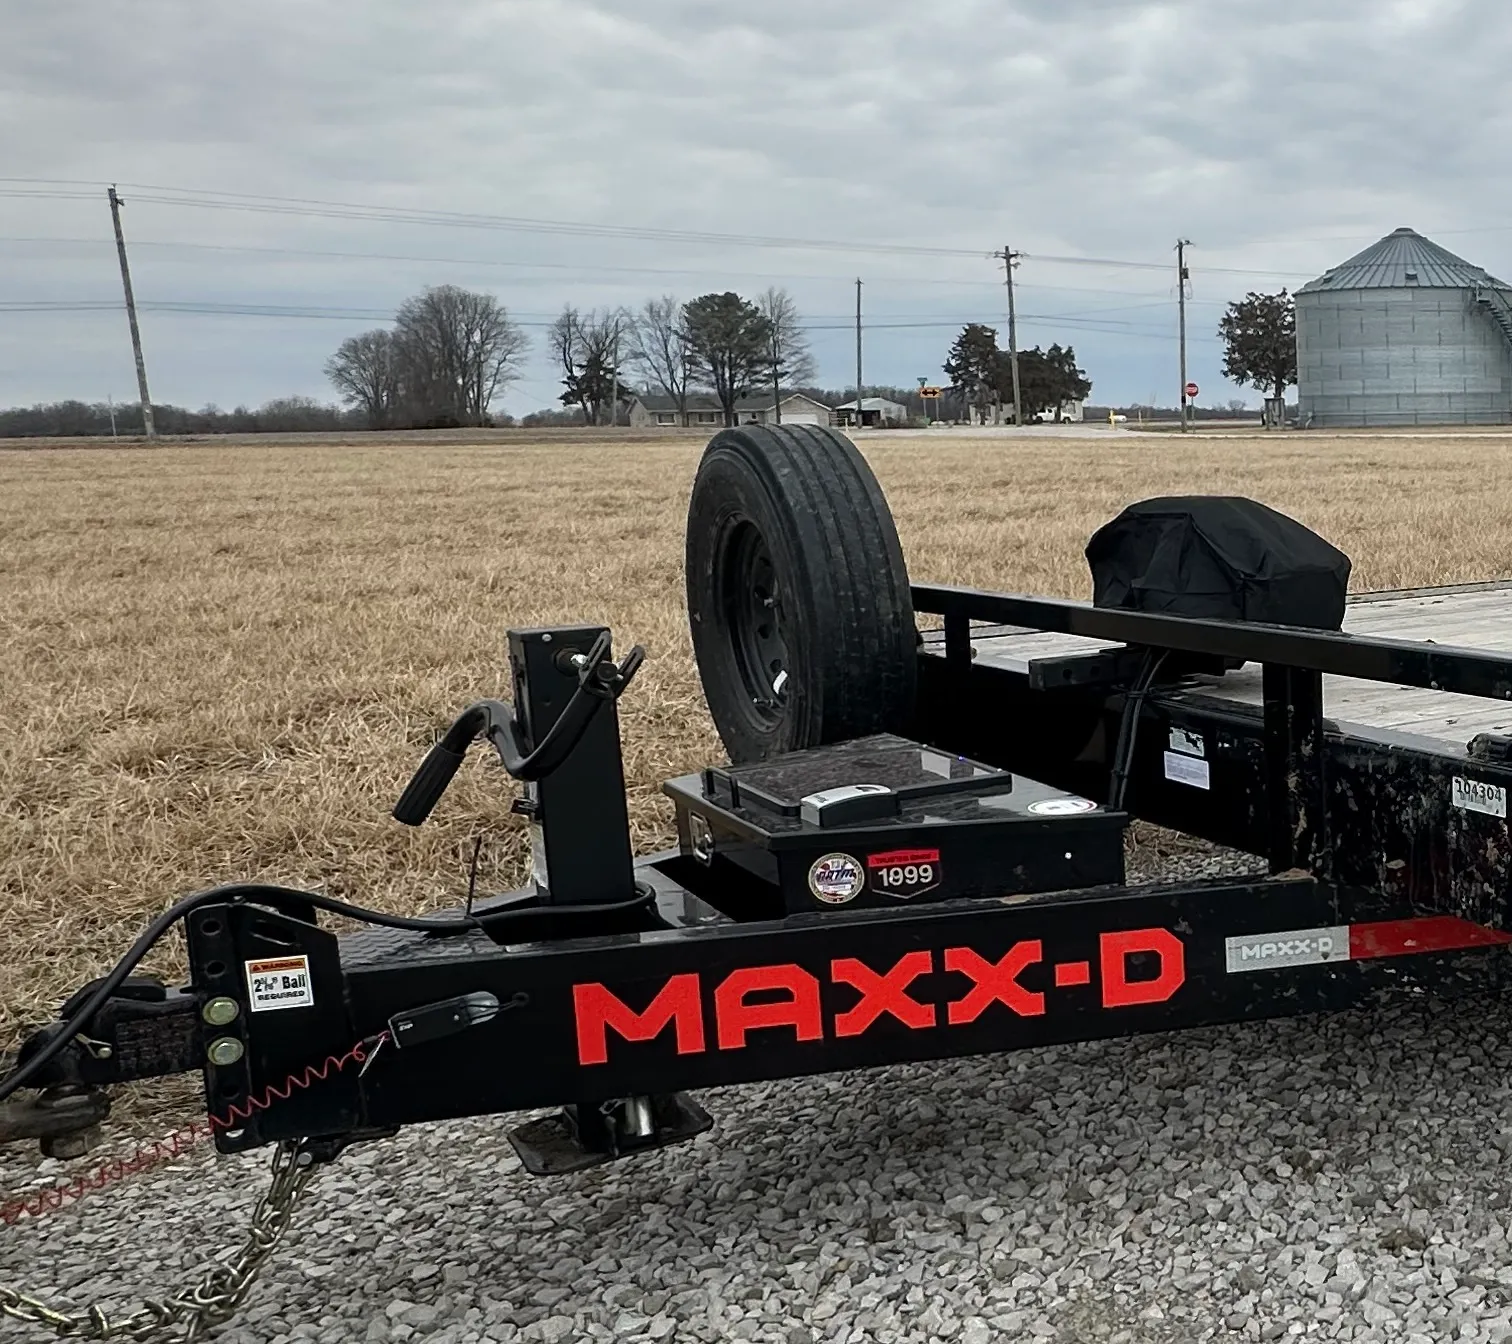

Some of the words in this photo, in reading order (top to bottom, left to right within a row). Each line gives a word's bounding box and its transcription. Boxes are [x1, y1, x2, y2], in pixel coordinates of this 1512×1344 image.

[1455, 779, 1502, 802] 104304
[1241, 937, 1333, 960] MAXX-D
[282, 974, 306, 989] Ball
[572, 928, 1185, 1065] MAXX-D
